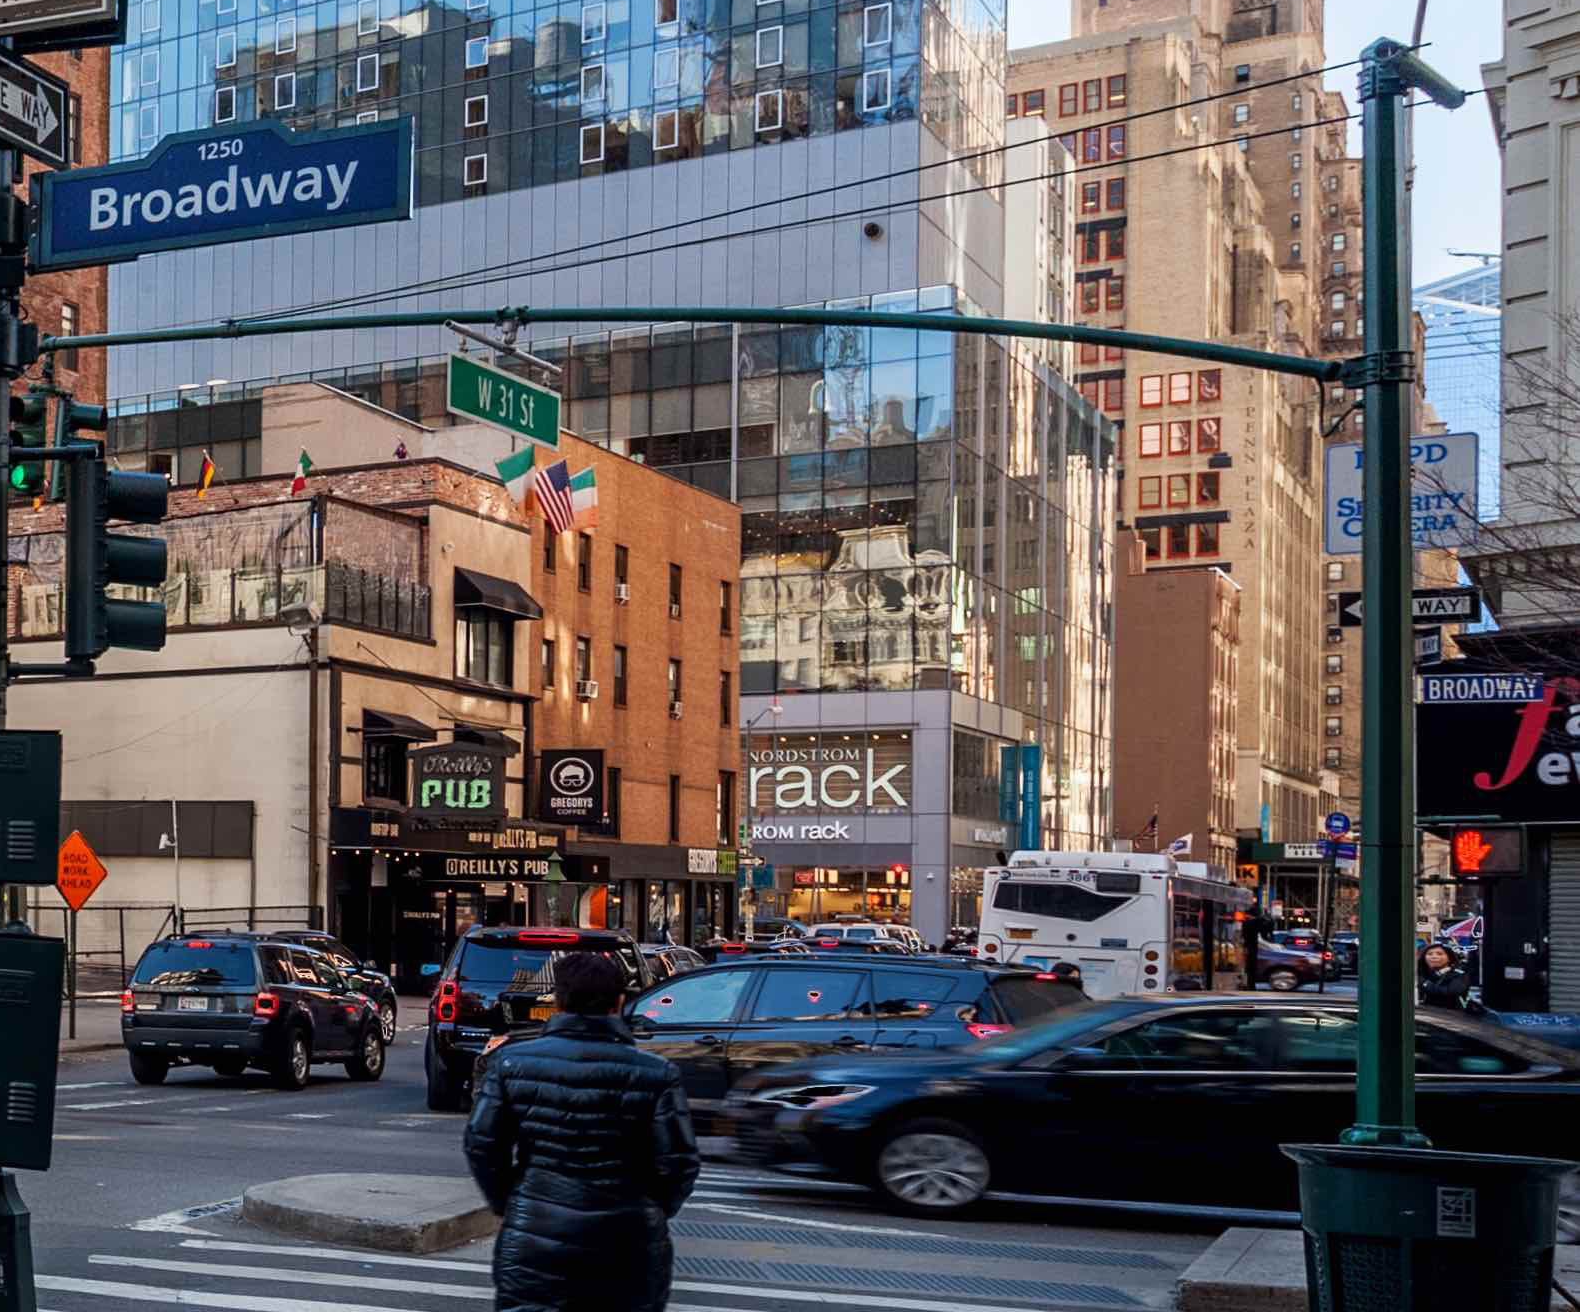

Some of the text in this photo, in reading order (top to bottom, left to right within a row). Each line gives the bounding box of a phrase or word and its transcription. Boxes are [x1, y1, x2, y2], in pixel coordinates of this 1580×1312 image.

[20, 92, 50, 130] WAY
[197, 138, 244, 161] 1250
[89, 160, 359, 231] Broadway
[477, 375, 535, 429] W 31 St
[1417, 599, 1462, 614] WAY
[1421, 639, 1436, 653] WAY
[1429, 678, 1538, 700] BROADWAY
[750, 748, 859, 763] NORDSTROM
[750, 747, 908, 808] rack
[421, 778, 492, 809] PUB
[550, 797, 594, 809] GREGORYS
[556, 808, 587, 816] COFFEE
[801, 821, 849, 839] rack
[63, 852, 88, 863] ROAD
[63, 866, 88, 875] WORK
[524, 859, 549, 875] PUB
